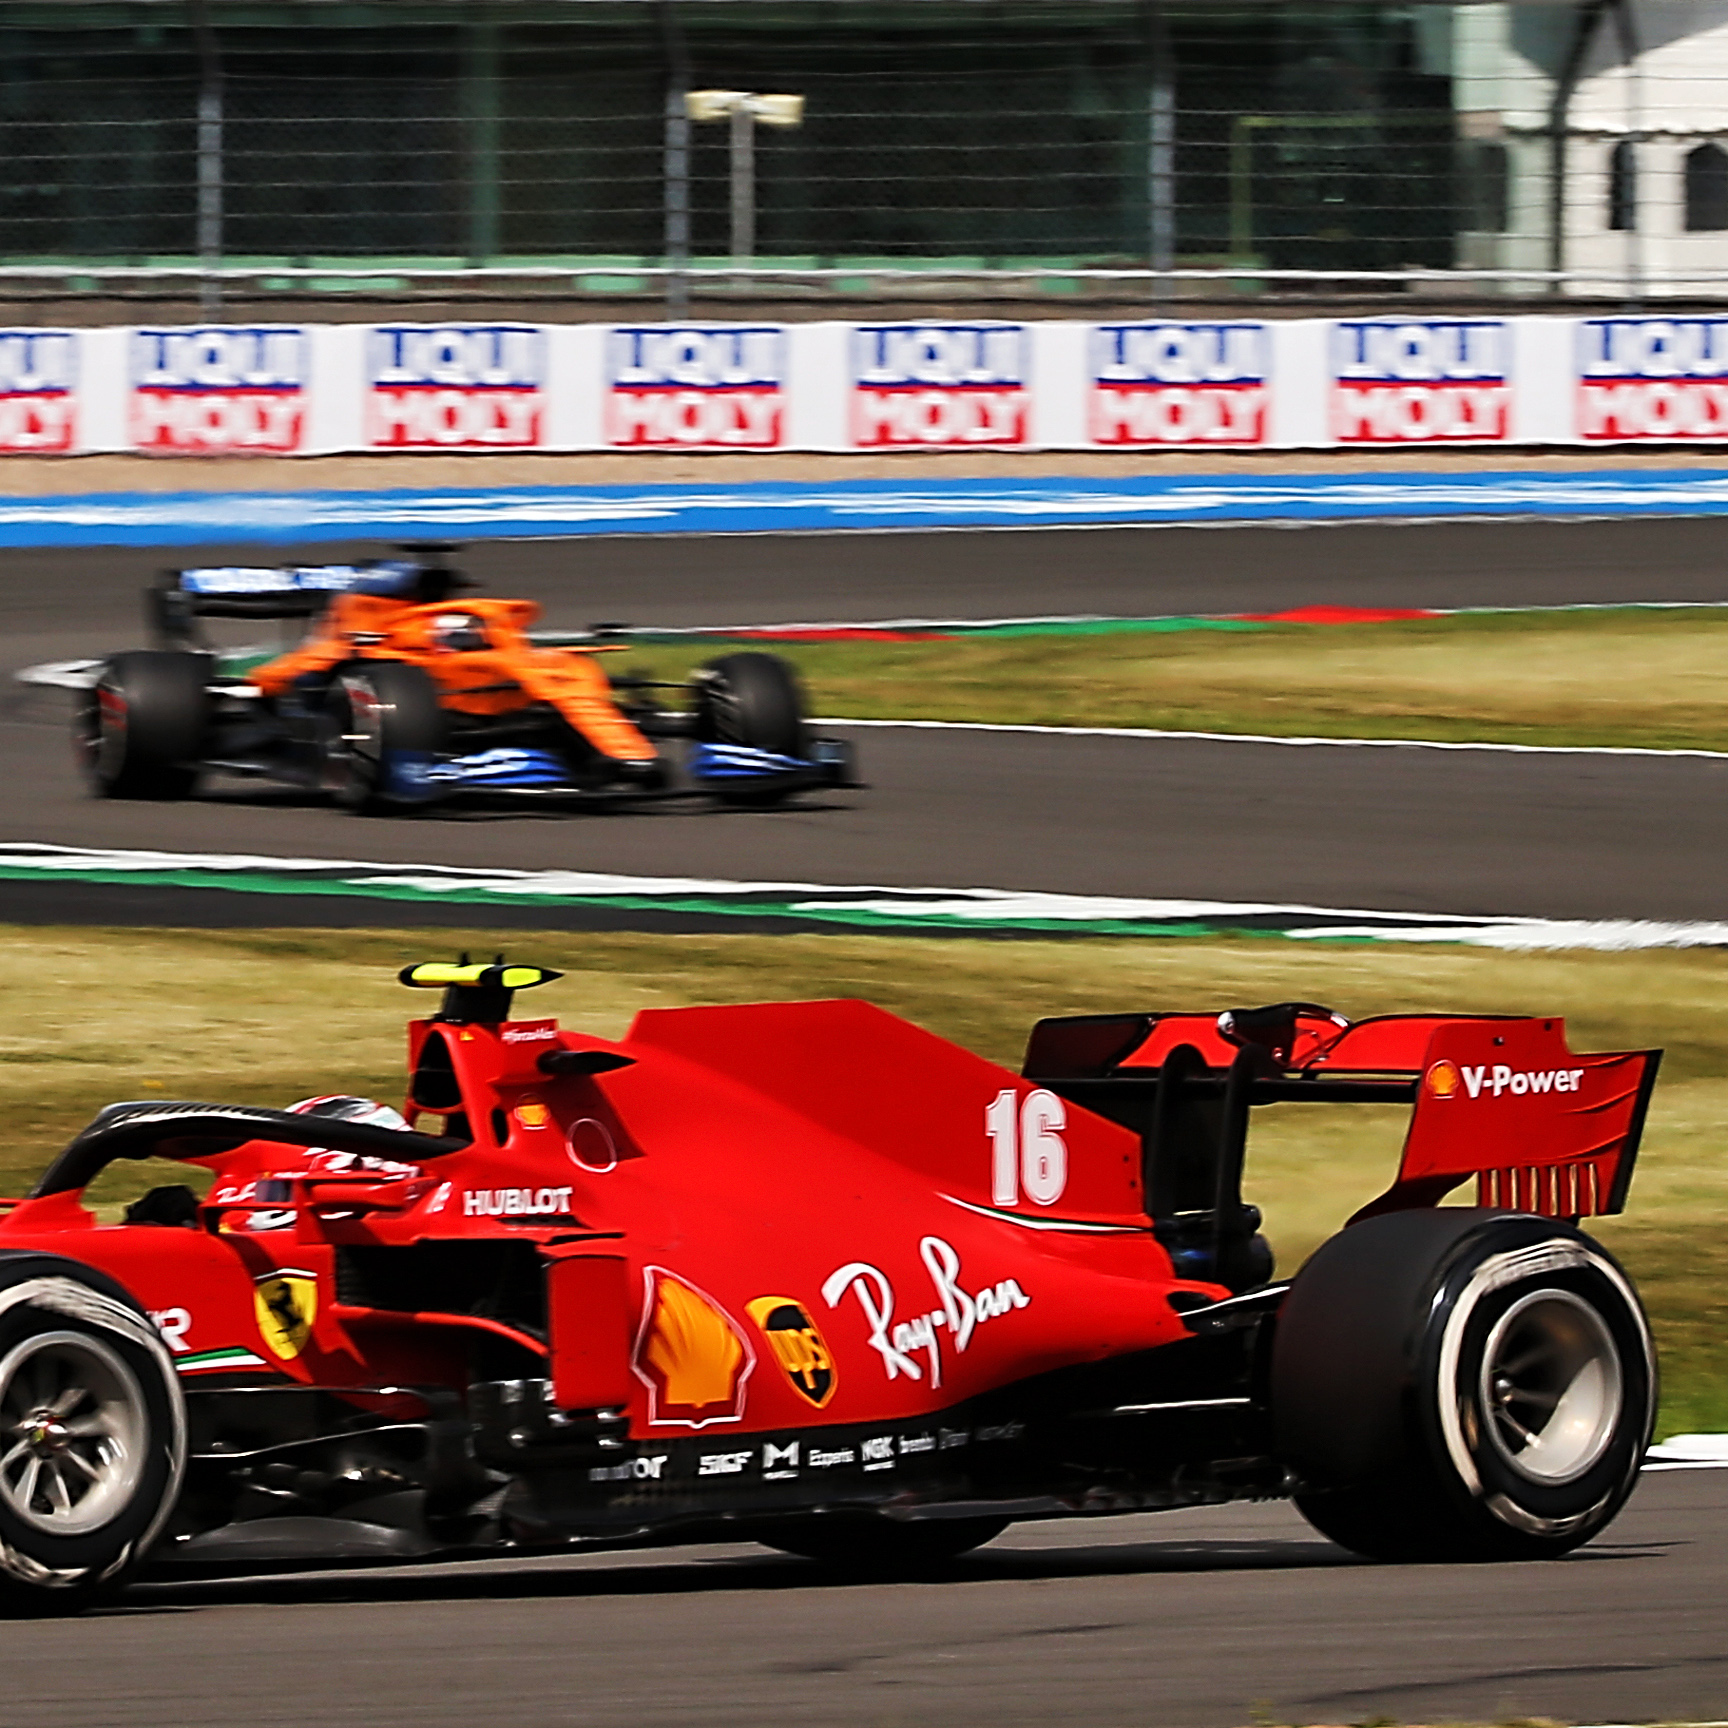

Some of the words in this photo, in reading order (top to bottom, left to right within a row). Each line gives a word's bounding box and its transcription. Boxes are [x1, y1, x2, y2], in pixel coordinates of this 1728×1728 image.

[135, 333, 306, 385] LIQUI
[372, 332, 543, 384] LIQUI
[610, 332, 786, 384] LIQUI
[853, 330, 1027, 383] LIQUI
[1093, 329, 1267, 380] LIQUI
[1335, 326, 1509, 378] LIQUI
[135, 395, 306, 445] MOLY
[372, 392, 543, 442] MOLY
[610, 392, 786, 442] MOLY
[853, 392, 1027, 441] MOLY
[1093, 389, 1267, 440] MOLY
[1335, 387, 1509, 438] MOLY
[1461, 1065, 1584, 1098] V-Power
[984, 1089, 1066, 1206] 16
[463, 1186, 574, 1216] HUBLOT
[822, 1236, 1030, 1389] Ray-Ban
